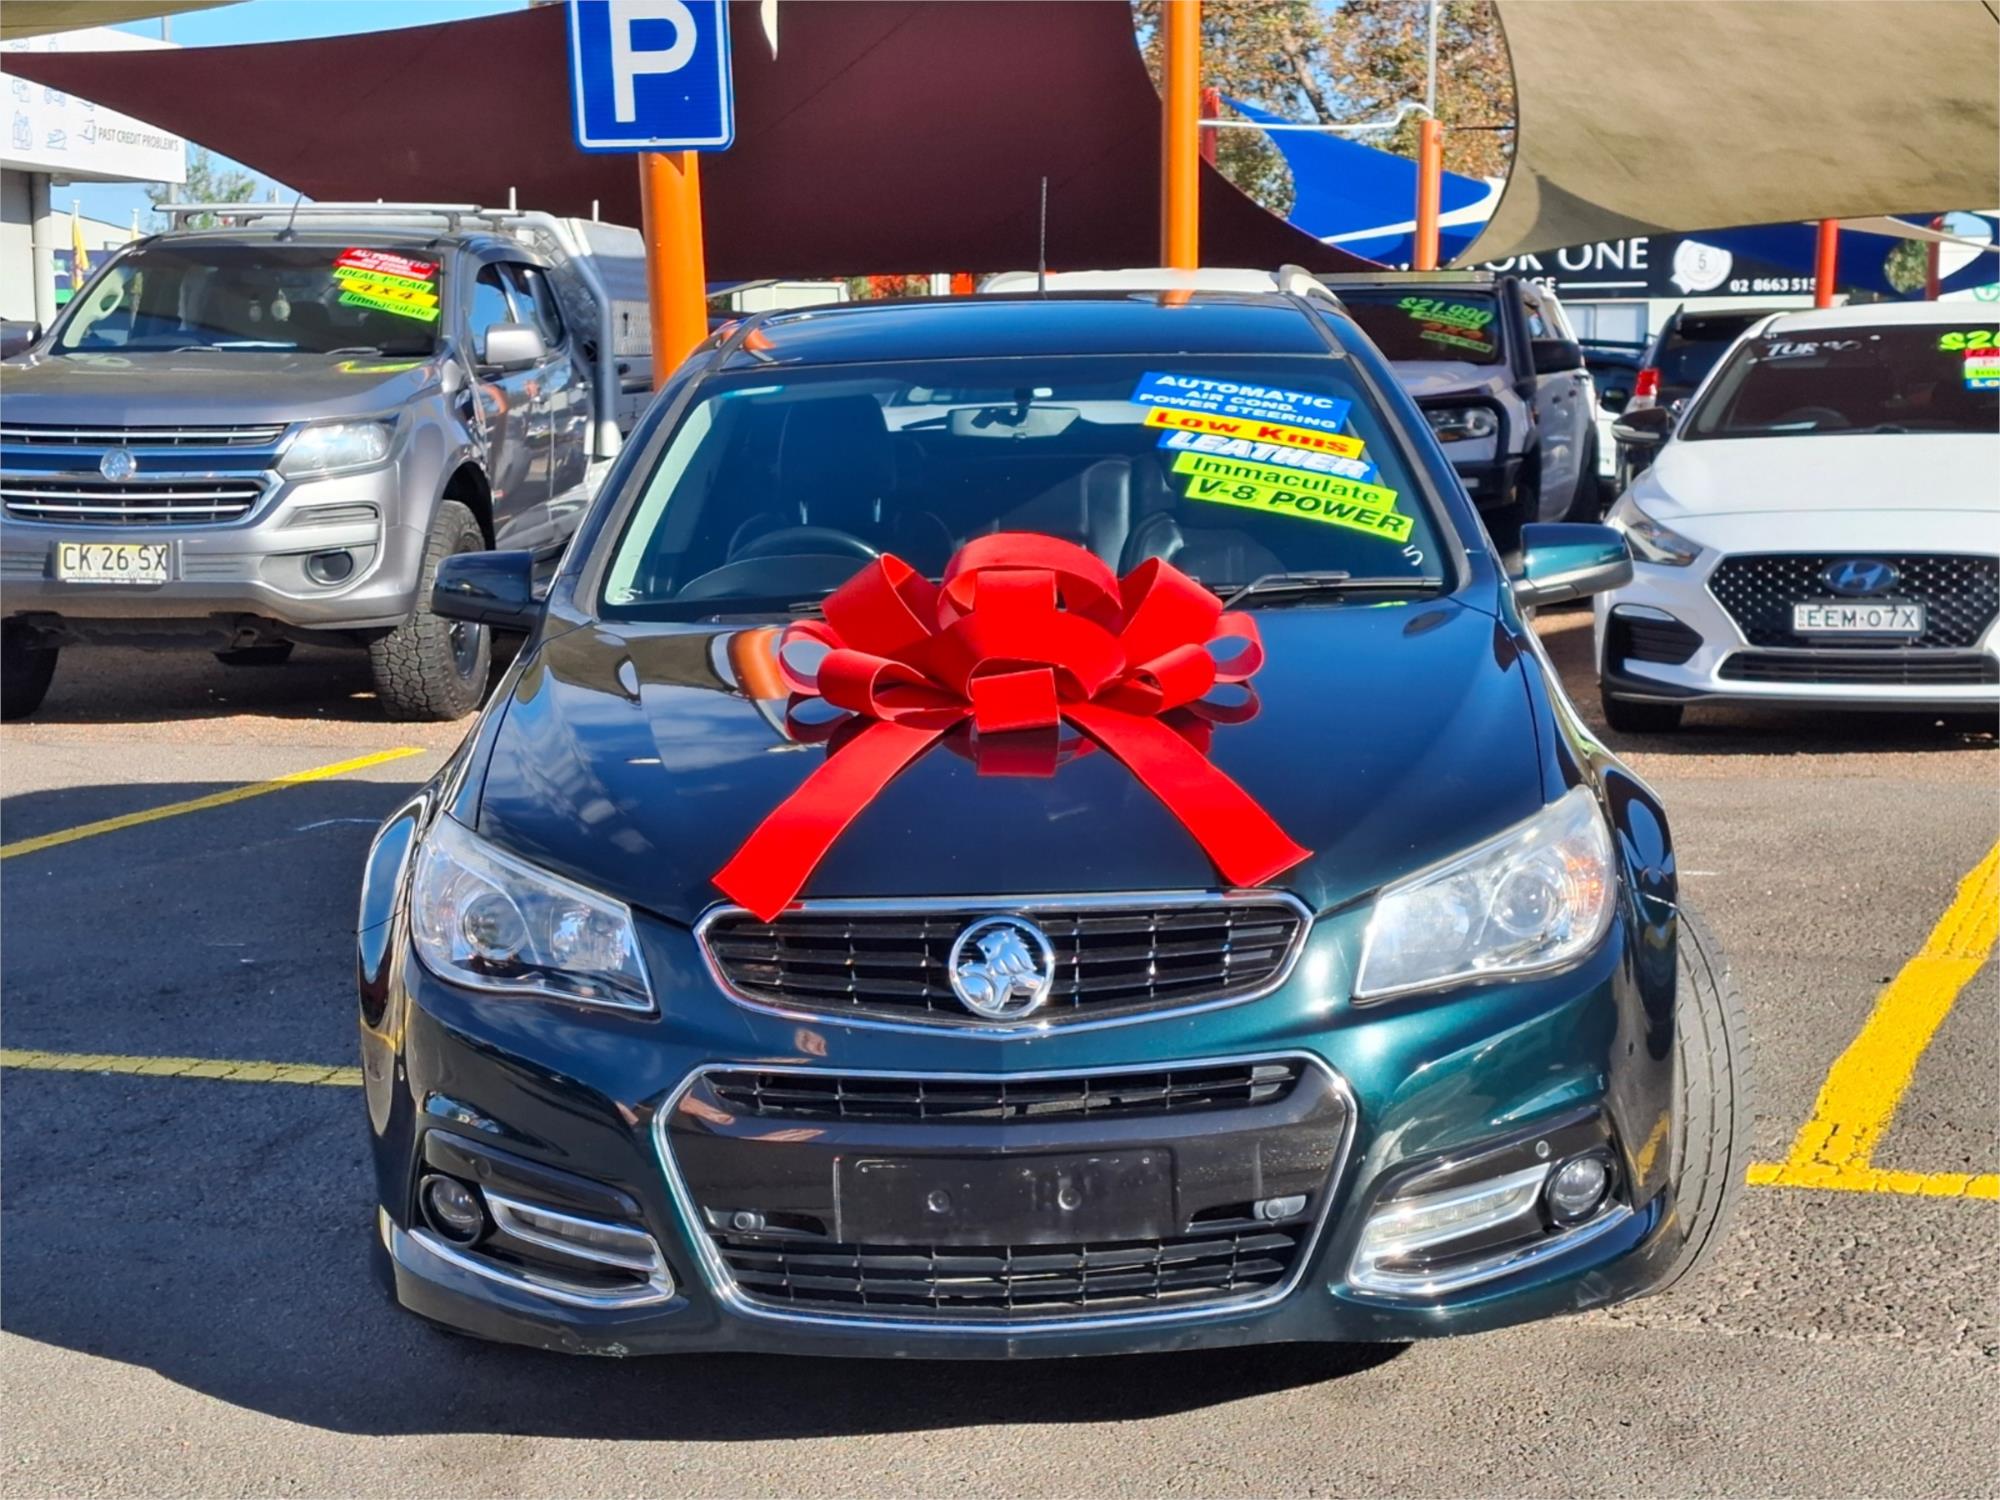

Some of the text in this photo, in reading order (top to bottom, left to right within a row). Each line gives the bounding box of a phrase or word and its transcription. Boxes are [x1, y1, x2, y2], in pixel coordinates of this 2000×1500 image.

[609, 0, 698, 123] P
[116, 130, 141, 146] CREDIT
[1557, 237, 1649, 271] ONE
[398, 279, 428, 292] CAR
[1730, 279, 1749, 292] 02
[1753, 278, 1789, 291] 8663
[1155, 375, 1334, 409] AUTOMATIC
[1186, 390, 1299, 413] AIR COND.
[1139, 393, 1337, 428] POWER STEERING
[1167, 431, 1371, 480] LEATHER
[1193, 457, 1380, 504] Immaculate
[1198, 478, 1405, 533] V-8 POWER
[64, 546, 166, 571] CK 26 SX
